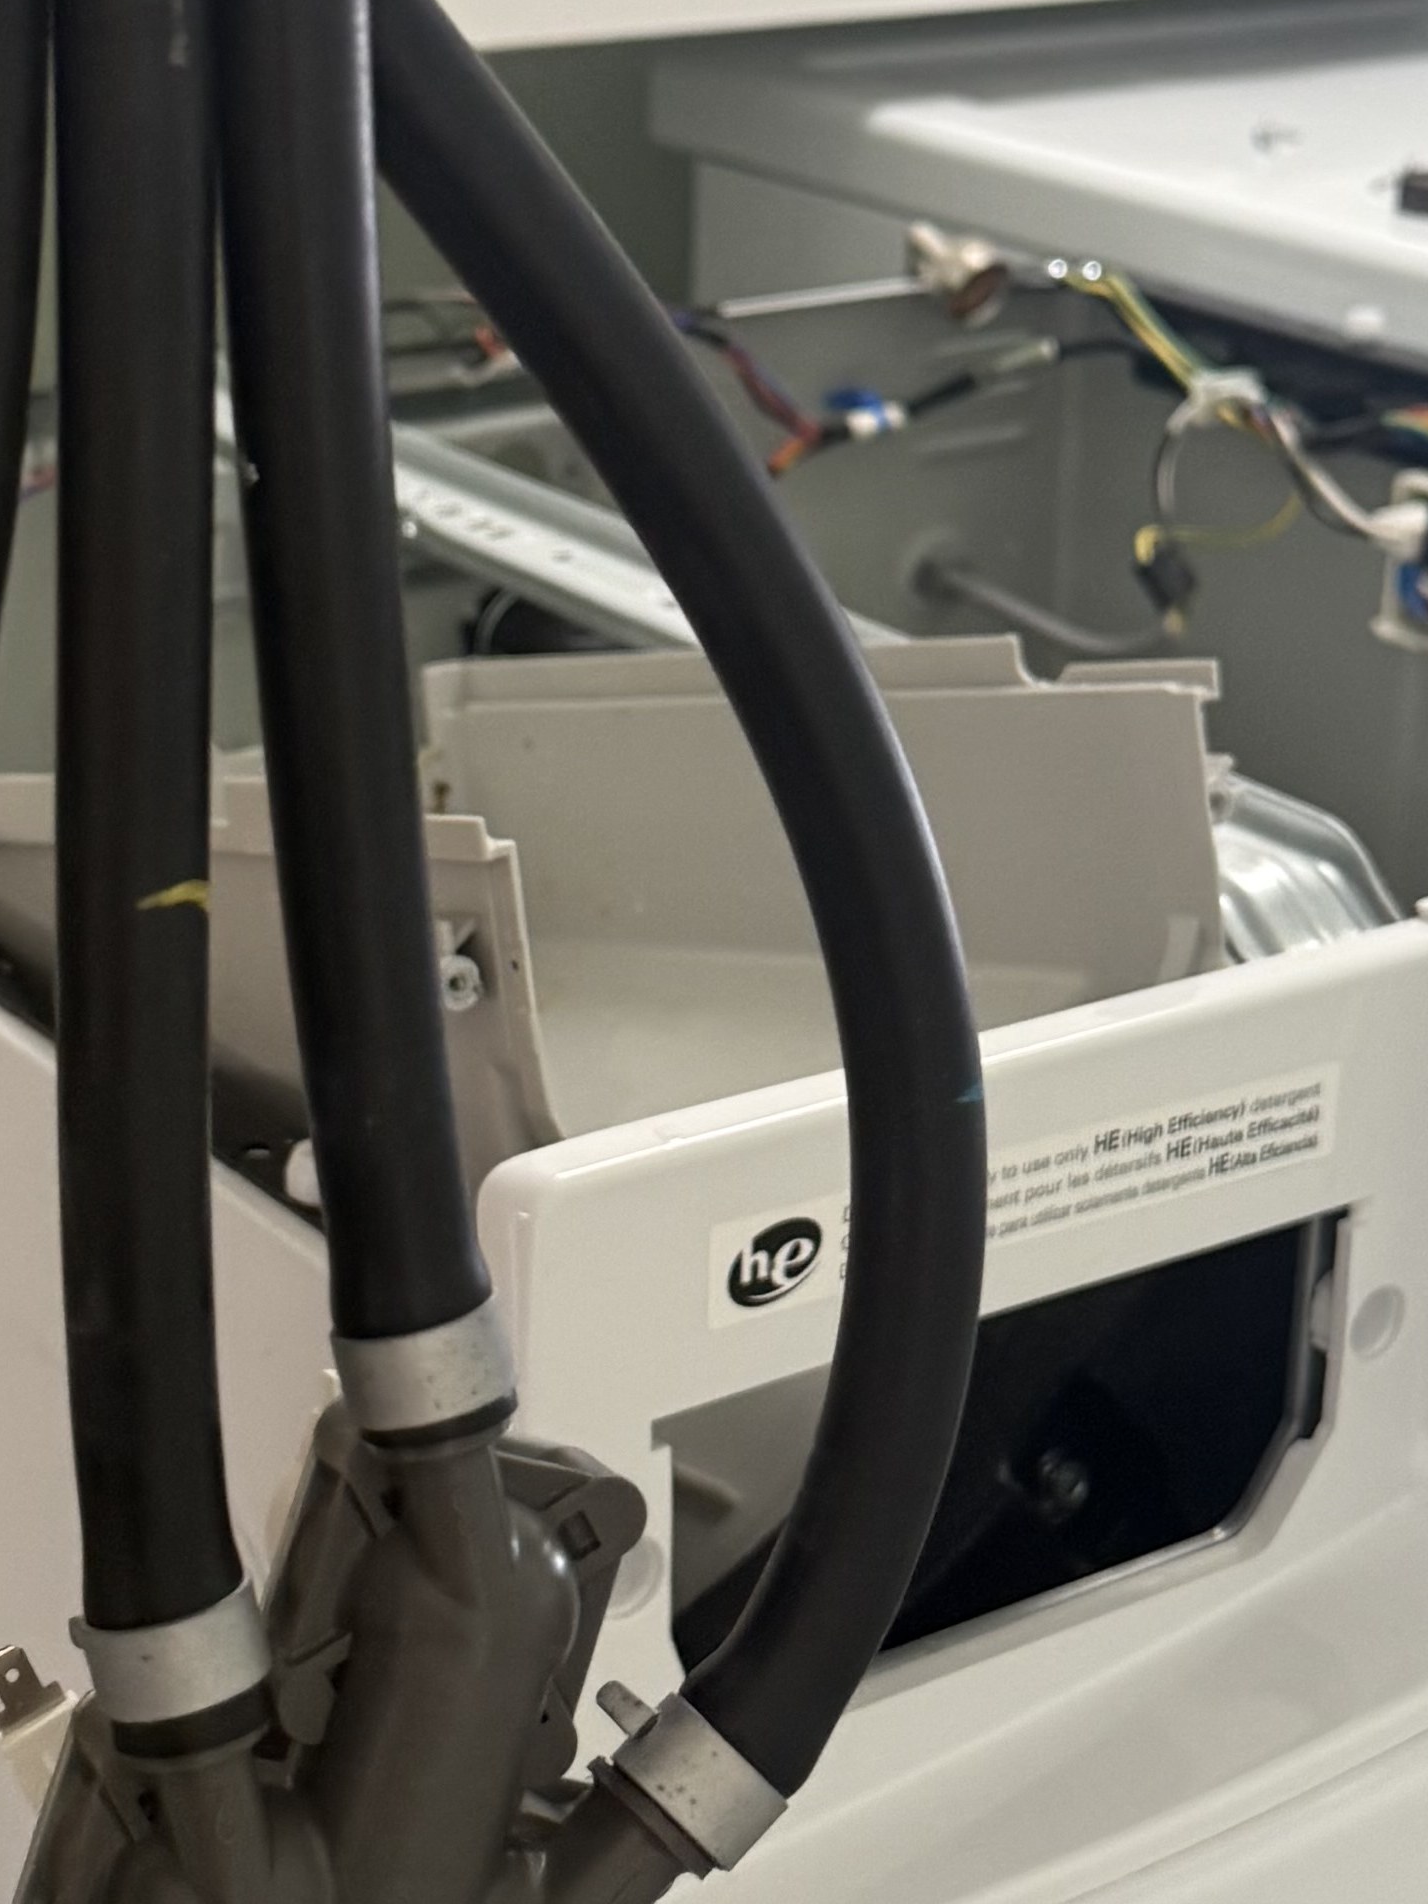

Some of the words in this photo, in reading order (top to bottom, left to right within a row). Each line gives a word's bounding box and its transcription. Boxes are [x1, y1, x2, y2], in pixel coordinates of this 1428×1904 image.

[1022, 1156, 1051, 1175] use
[1054, 1145, 1089, 1170] only
[1166, 1099, 1247, 1135] Efficiency)
[1024, 1178, 1063, 1203] pour
[735, 1232, 819, 1290] he
